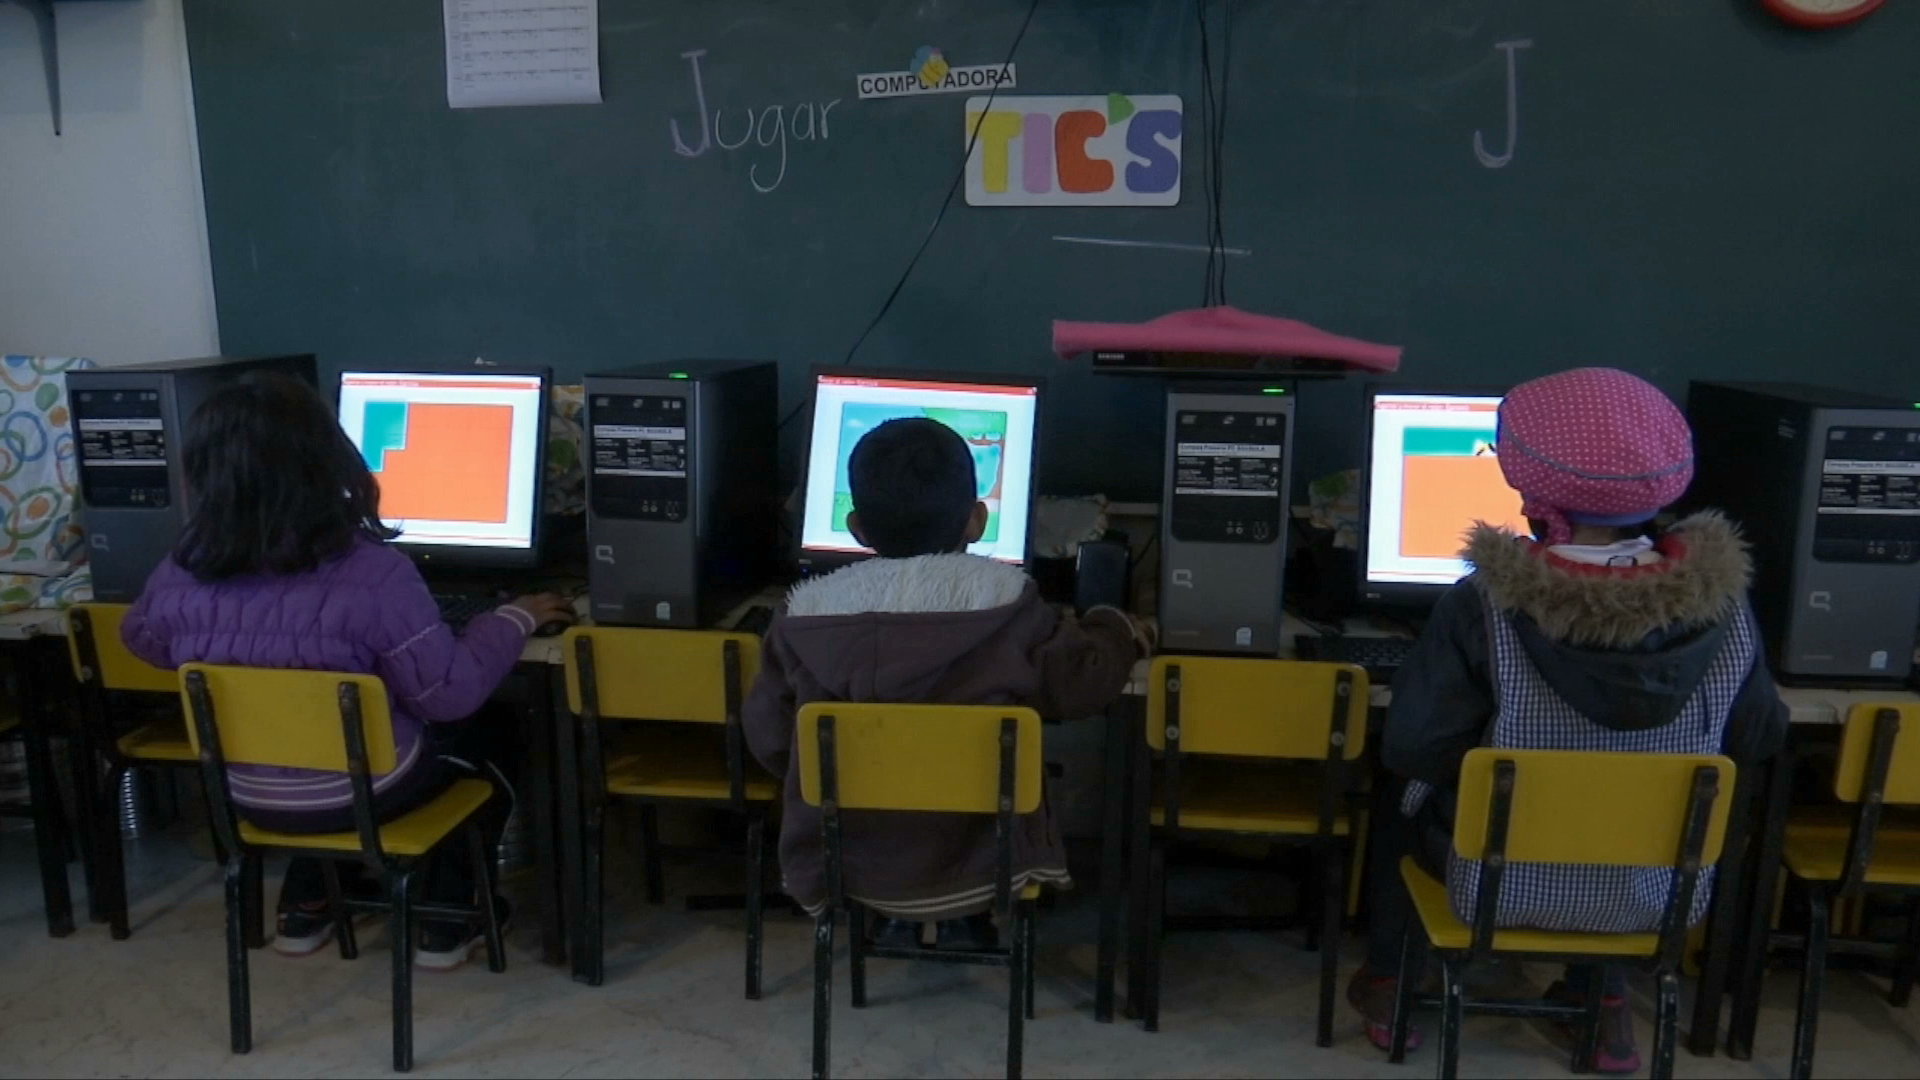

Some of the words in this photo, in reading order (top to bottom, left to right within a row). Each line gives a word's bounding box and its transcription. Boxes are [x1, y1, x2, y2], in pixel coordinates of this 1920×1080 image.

[669, 49, 842, 192] Jugar
[859, 67, 1013, 94] COMPUADORA
[1473, 39, 1534, 168] J
